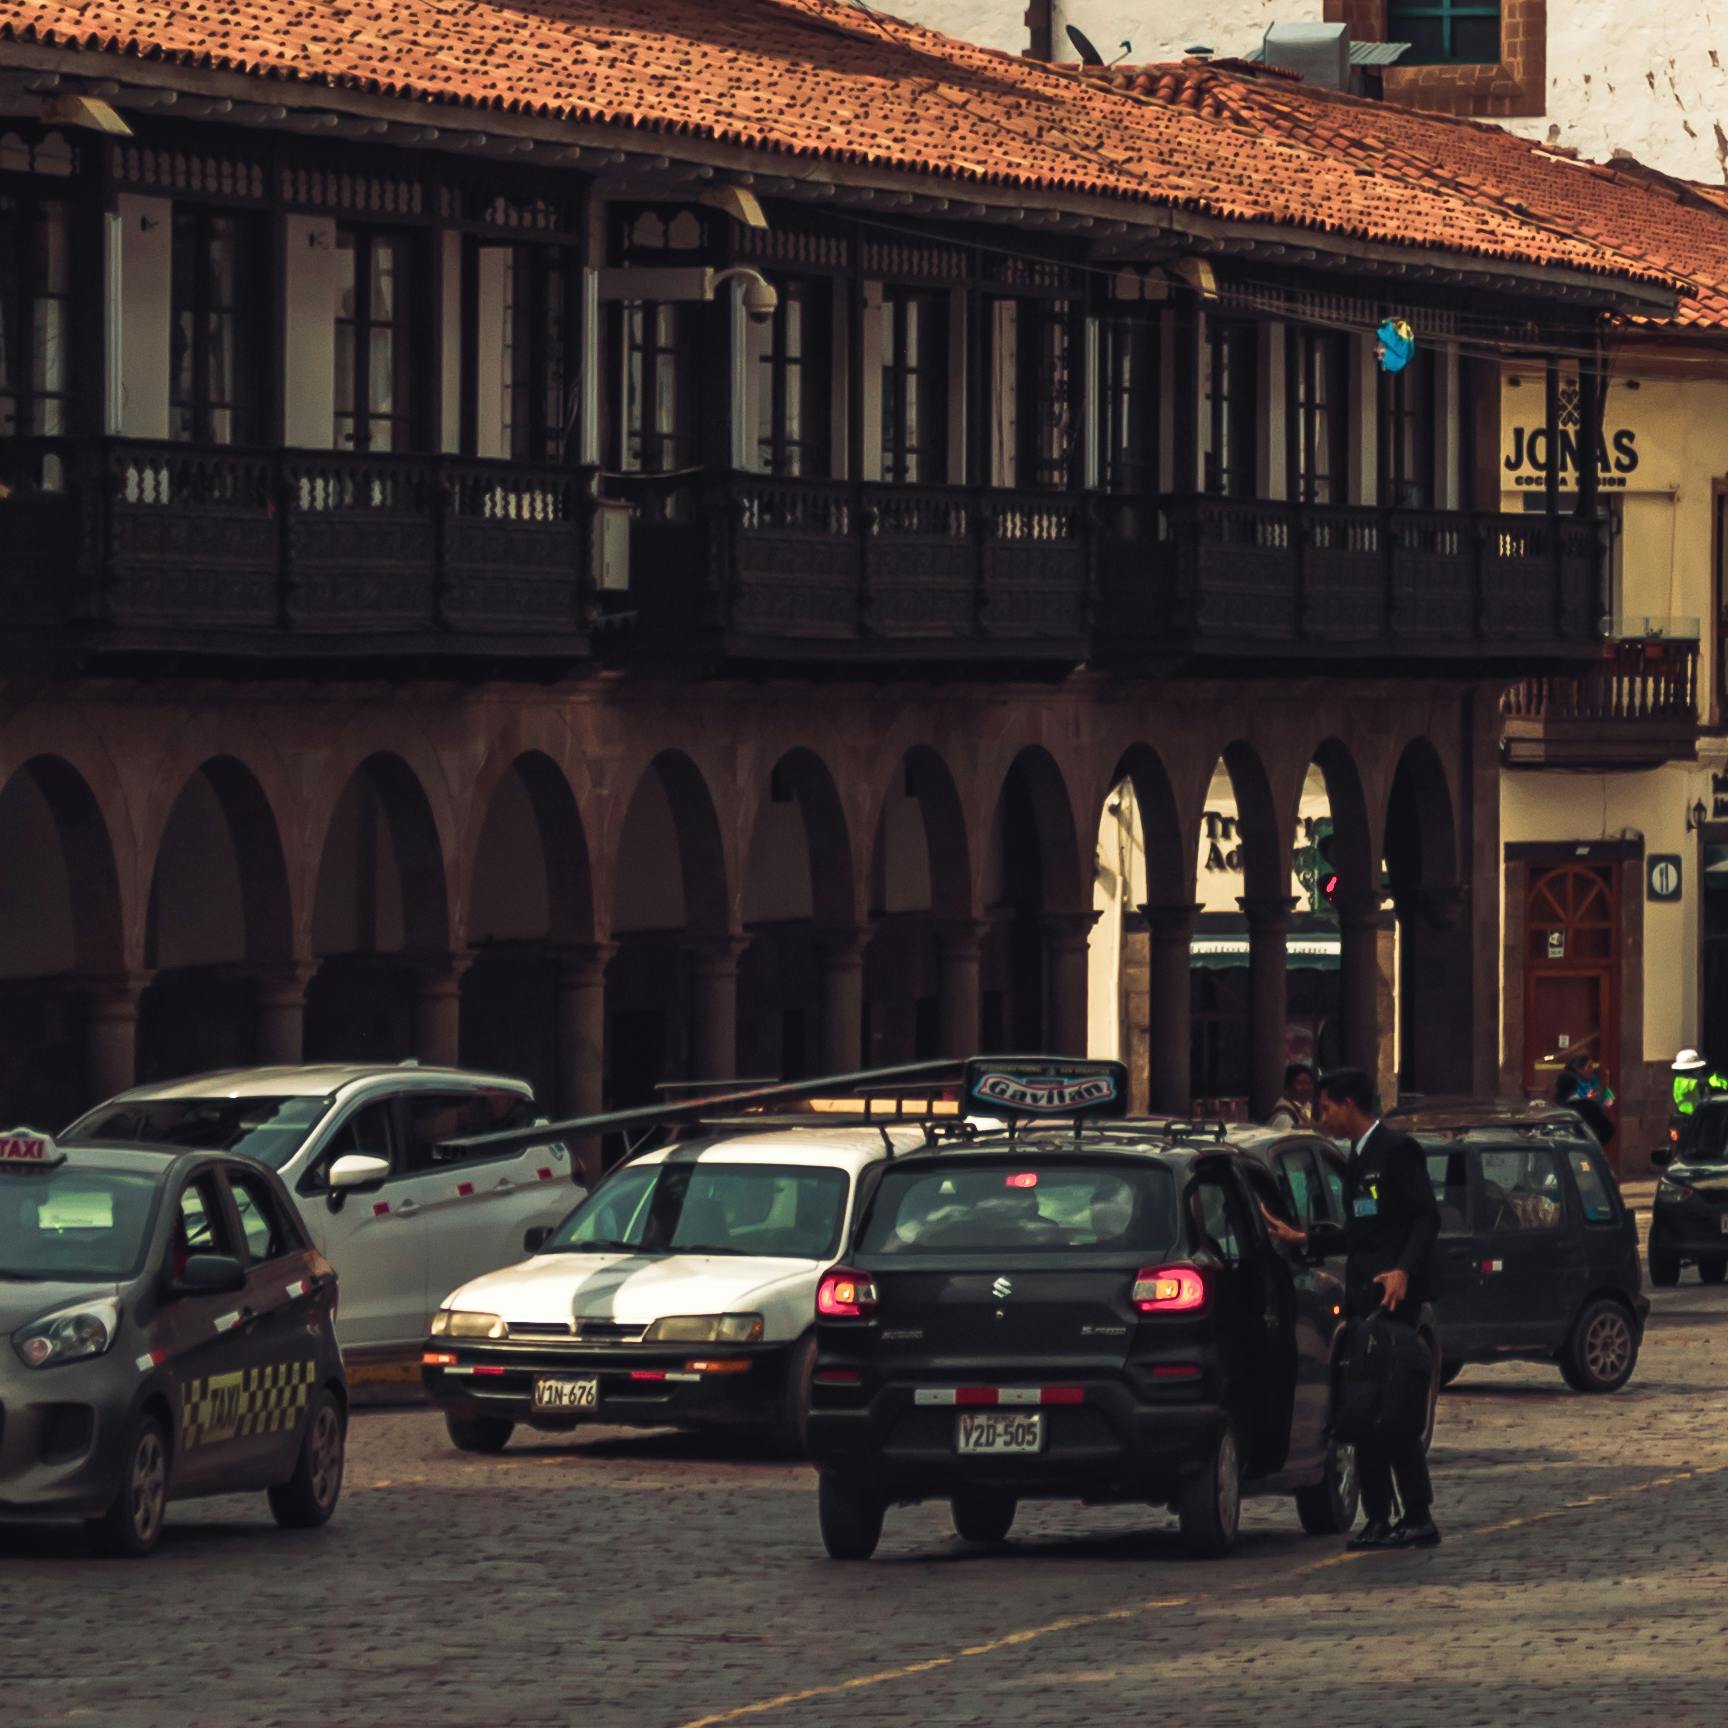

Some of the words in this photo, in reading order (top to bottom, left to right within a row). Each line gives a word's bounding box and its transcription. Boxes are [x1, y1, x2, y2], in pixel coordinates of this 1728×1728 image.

[0, 1140, 44, 1160] TAXI
[537, 1385, 594, 1405] V1N-676
[209, 1386, 240, 1428] TAXI
